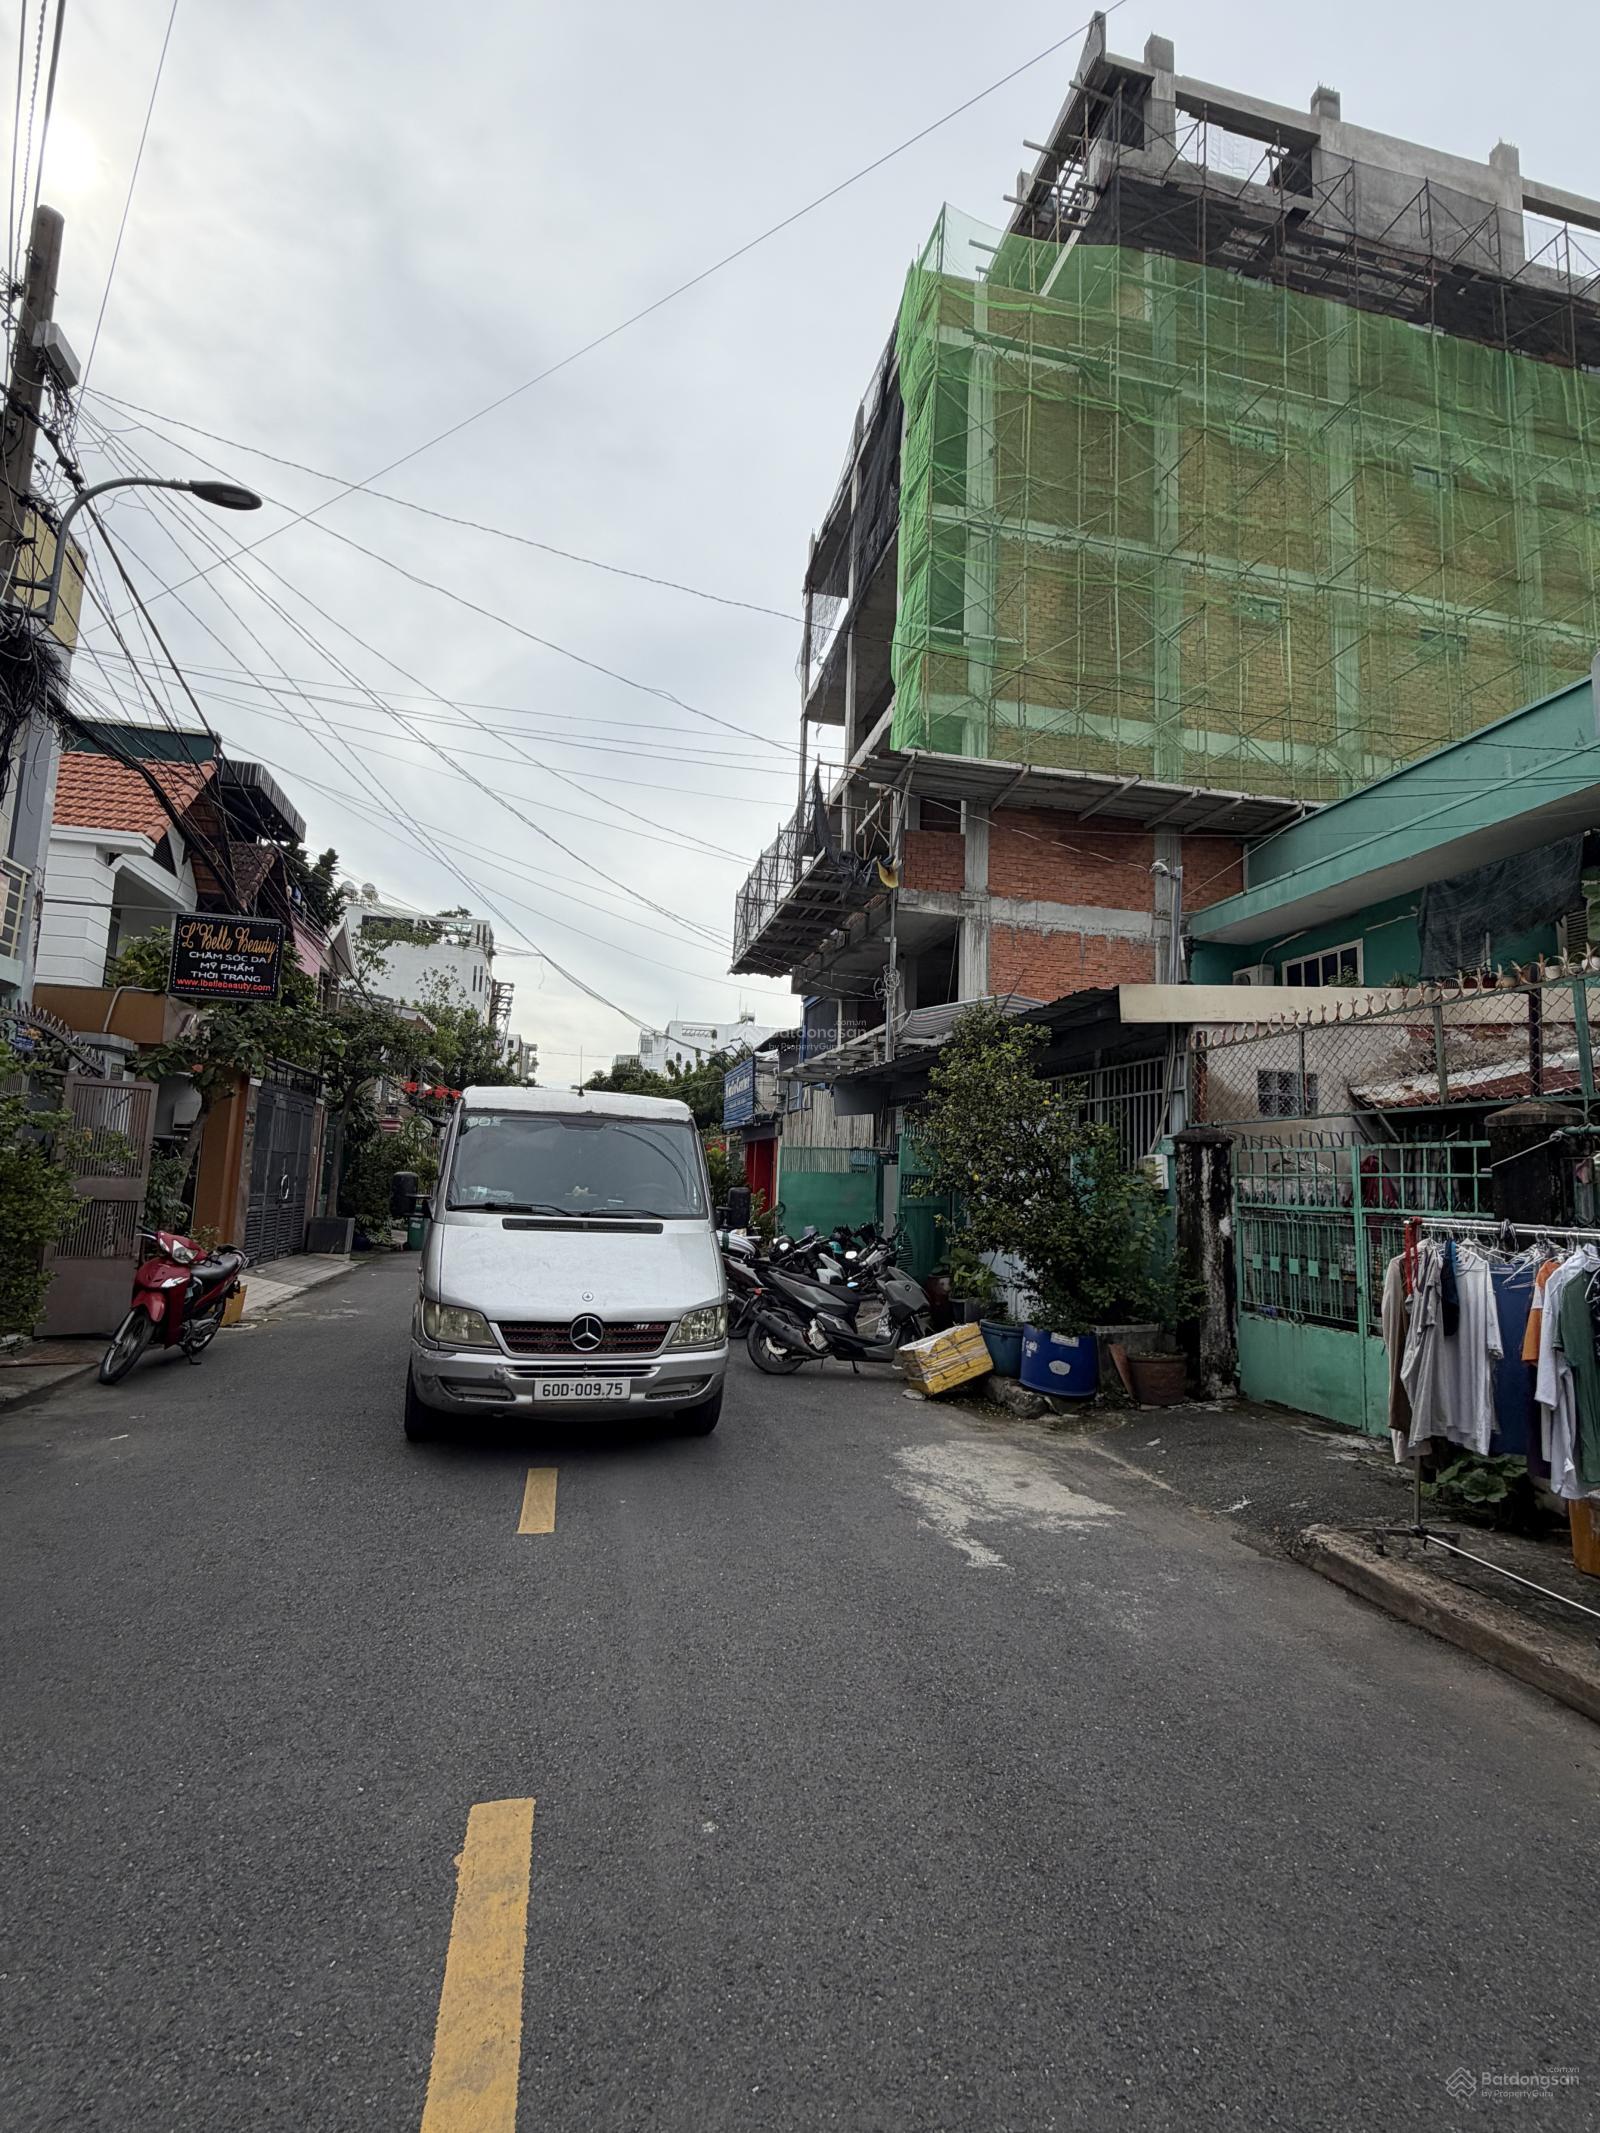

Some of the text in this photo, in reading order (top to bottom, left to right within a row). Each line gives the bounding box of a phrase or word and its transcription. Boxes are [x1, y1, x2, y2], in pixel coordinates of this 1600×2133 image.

[181, 922, 278, 963] L'Belle Beauty
[251, 956, 267, 964] DA
[221, 973, 261, 983] TRANG
[542, 1383, 623, 1397] 60D-009.75
